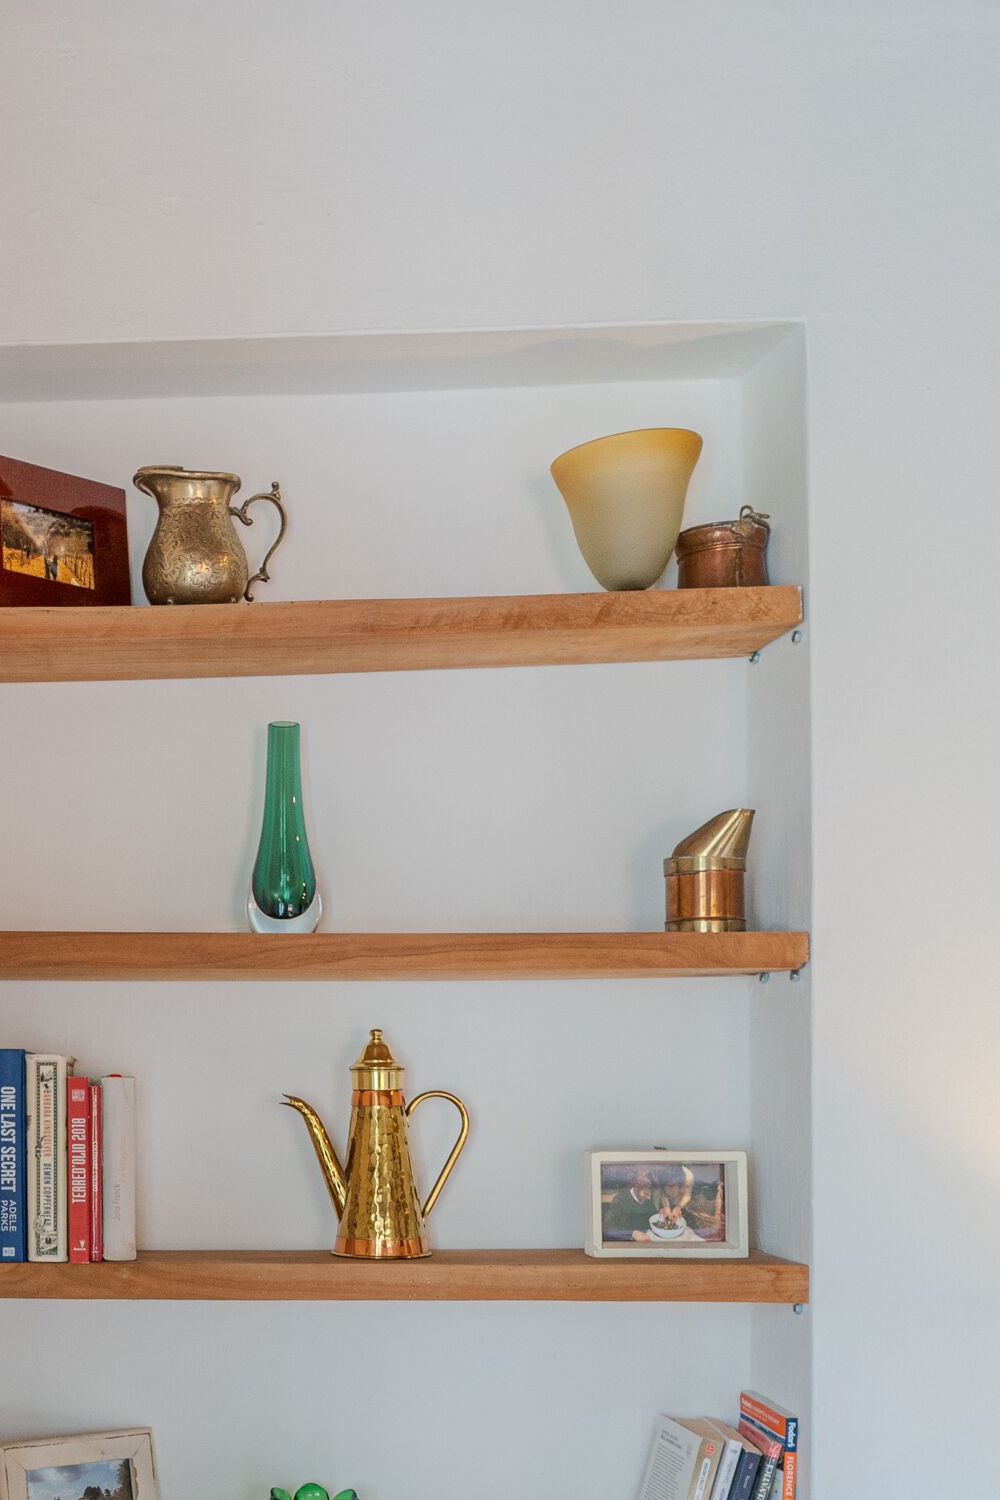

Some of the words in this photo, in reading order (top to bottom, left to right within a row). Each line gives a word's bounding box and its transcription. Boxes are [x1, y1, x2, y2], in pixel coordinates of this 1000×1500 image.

[0, 1086, 16, 1111] ONE
[0, 1113, 16, 1144] LAST
[71, 1117, 87, 1141] 2018
[0, 1146, 17, 1193] SECRET
[43, 1163, 52, 1185] DEMON
[0, 1199, 9, 1232] PARKS
[9, 1199, 17, 1232] ADELE
[785, 1456, 795, 1496] FLORENCE
